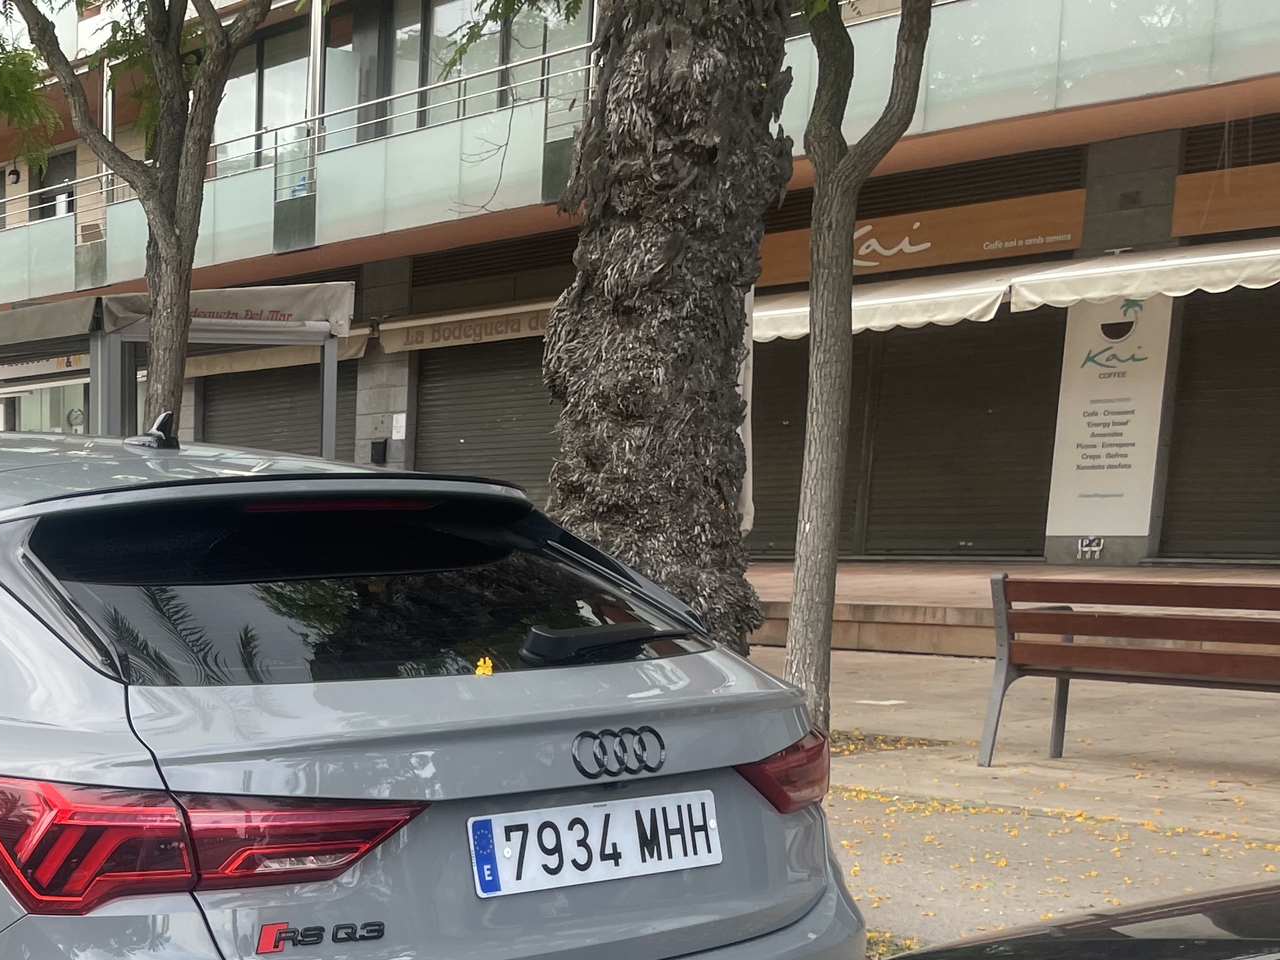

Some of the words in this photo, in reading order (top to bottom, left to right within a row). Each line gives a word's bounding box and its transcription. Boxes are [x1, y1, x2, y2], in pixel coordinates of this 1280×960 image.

[190, 308, 239, 319] degueta
[245, 309, 264, 320] Del
[403, 327, 425, 346] La
[429, 315, 521, 343] Bodegueta
[1080, 346, 1149, 369] Kai
[1098, 371, 1128, 380] COFFEE
[1082, 539, 1090, 547] P
[483, 864, 493, 881] E
[503, 812, 623, 882] 7934
[634, 801, 713, 864] MHH
[272, 925, 326, 949] RS
[331, 920, 386, 944] Q3
